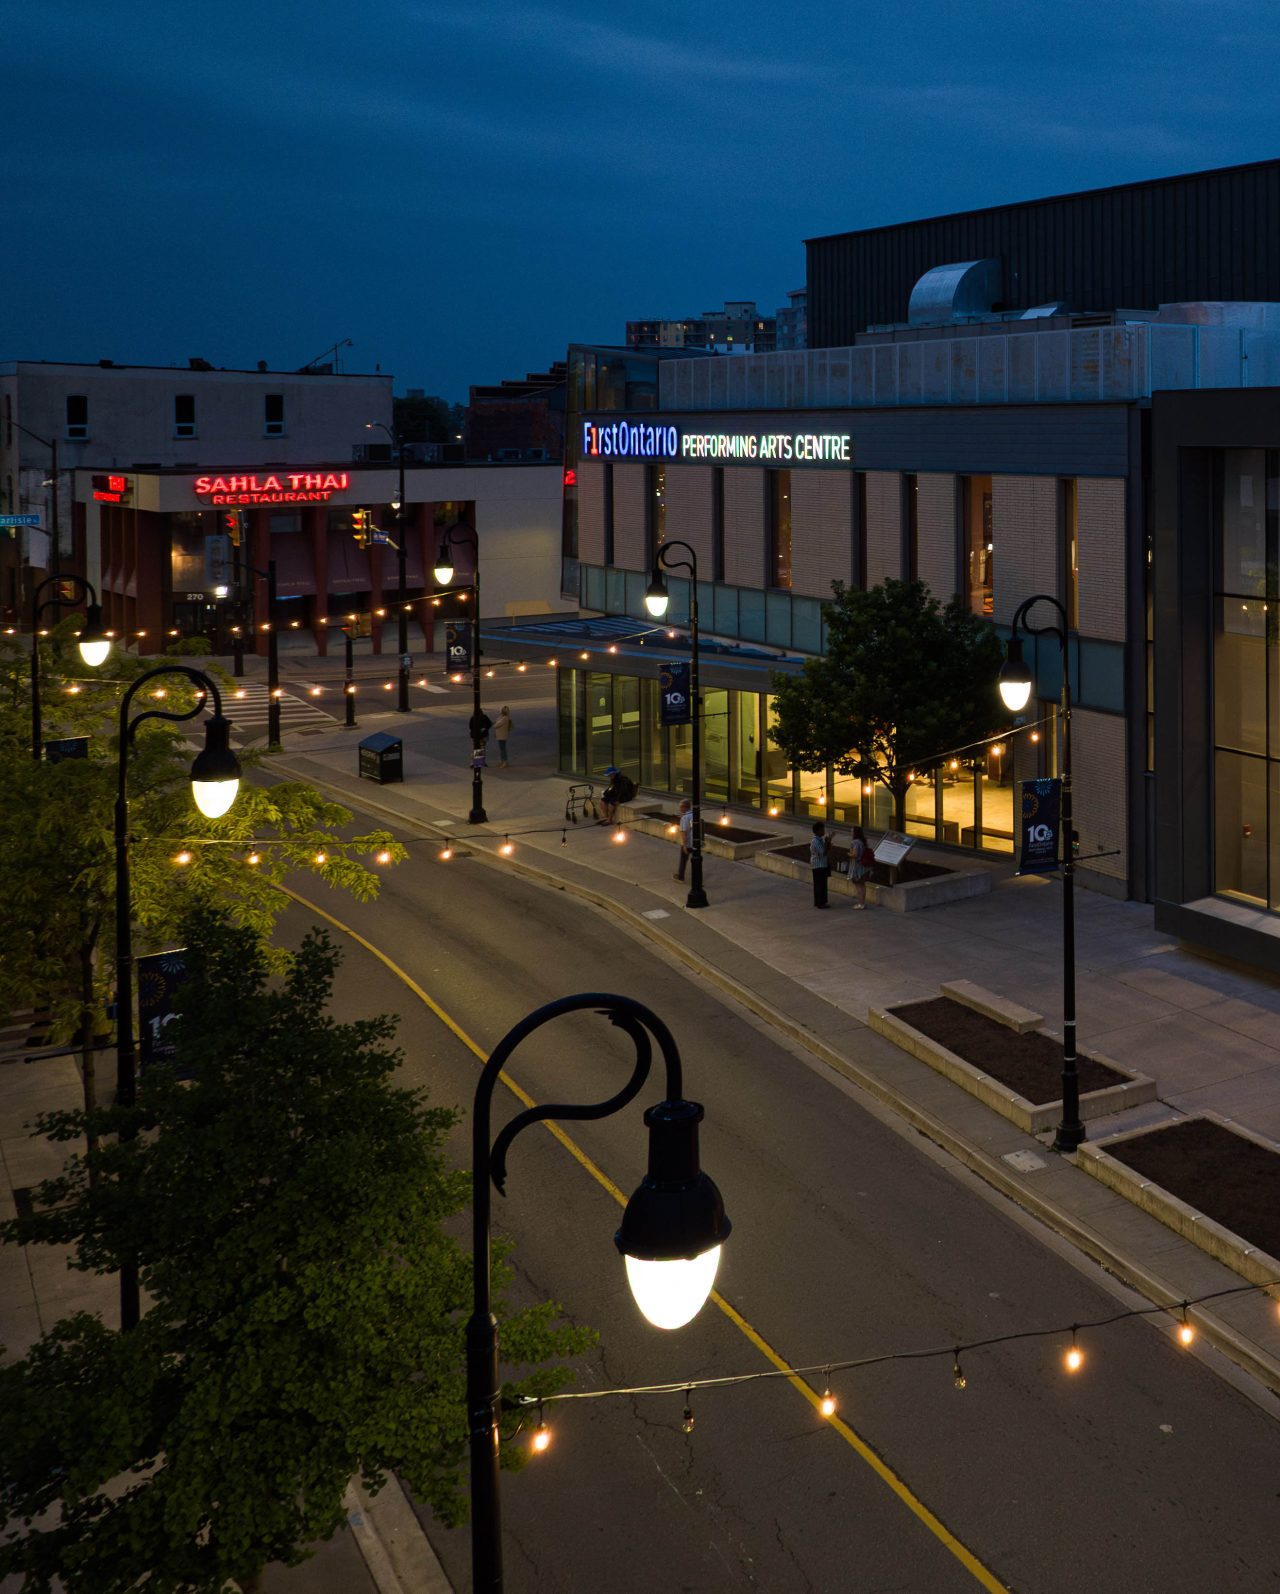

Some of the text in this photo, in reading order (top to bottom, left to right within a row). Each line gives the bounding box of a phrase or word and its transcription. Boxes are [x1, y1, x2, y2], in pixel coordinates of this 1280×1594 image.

[682, 434, 757, 458] PERFORMING
[759, 434, 793, 459] ARTS
[795, 434, 850, 460] CENTRE
[195, 472, 348, 494] SAHLA THAI
[213, 491, 333, 505] RESTAURANT
[187, 593, 204, 601] 270
[664, 692, 682, 705] 10
[1027, 824, 1050, 843] 10
